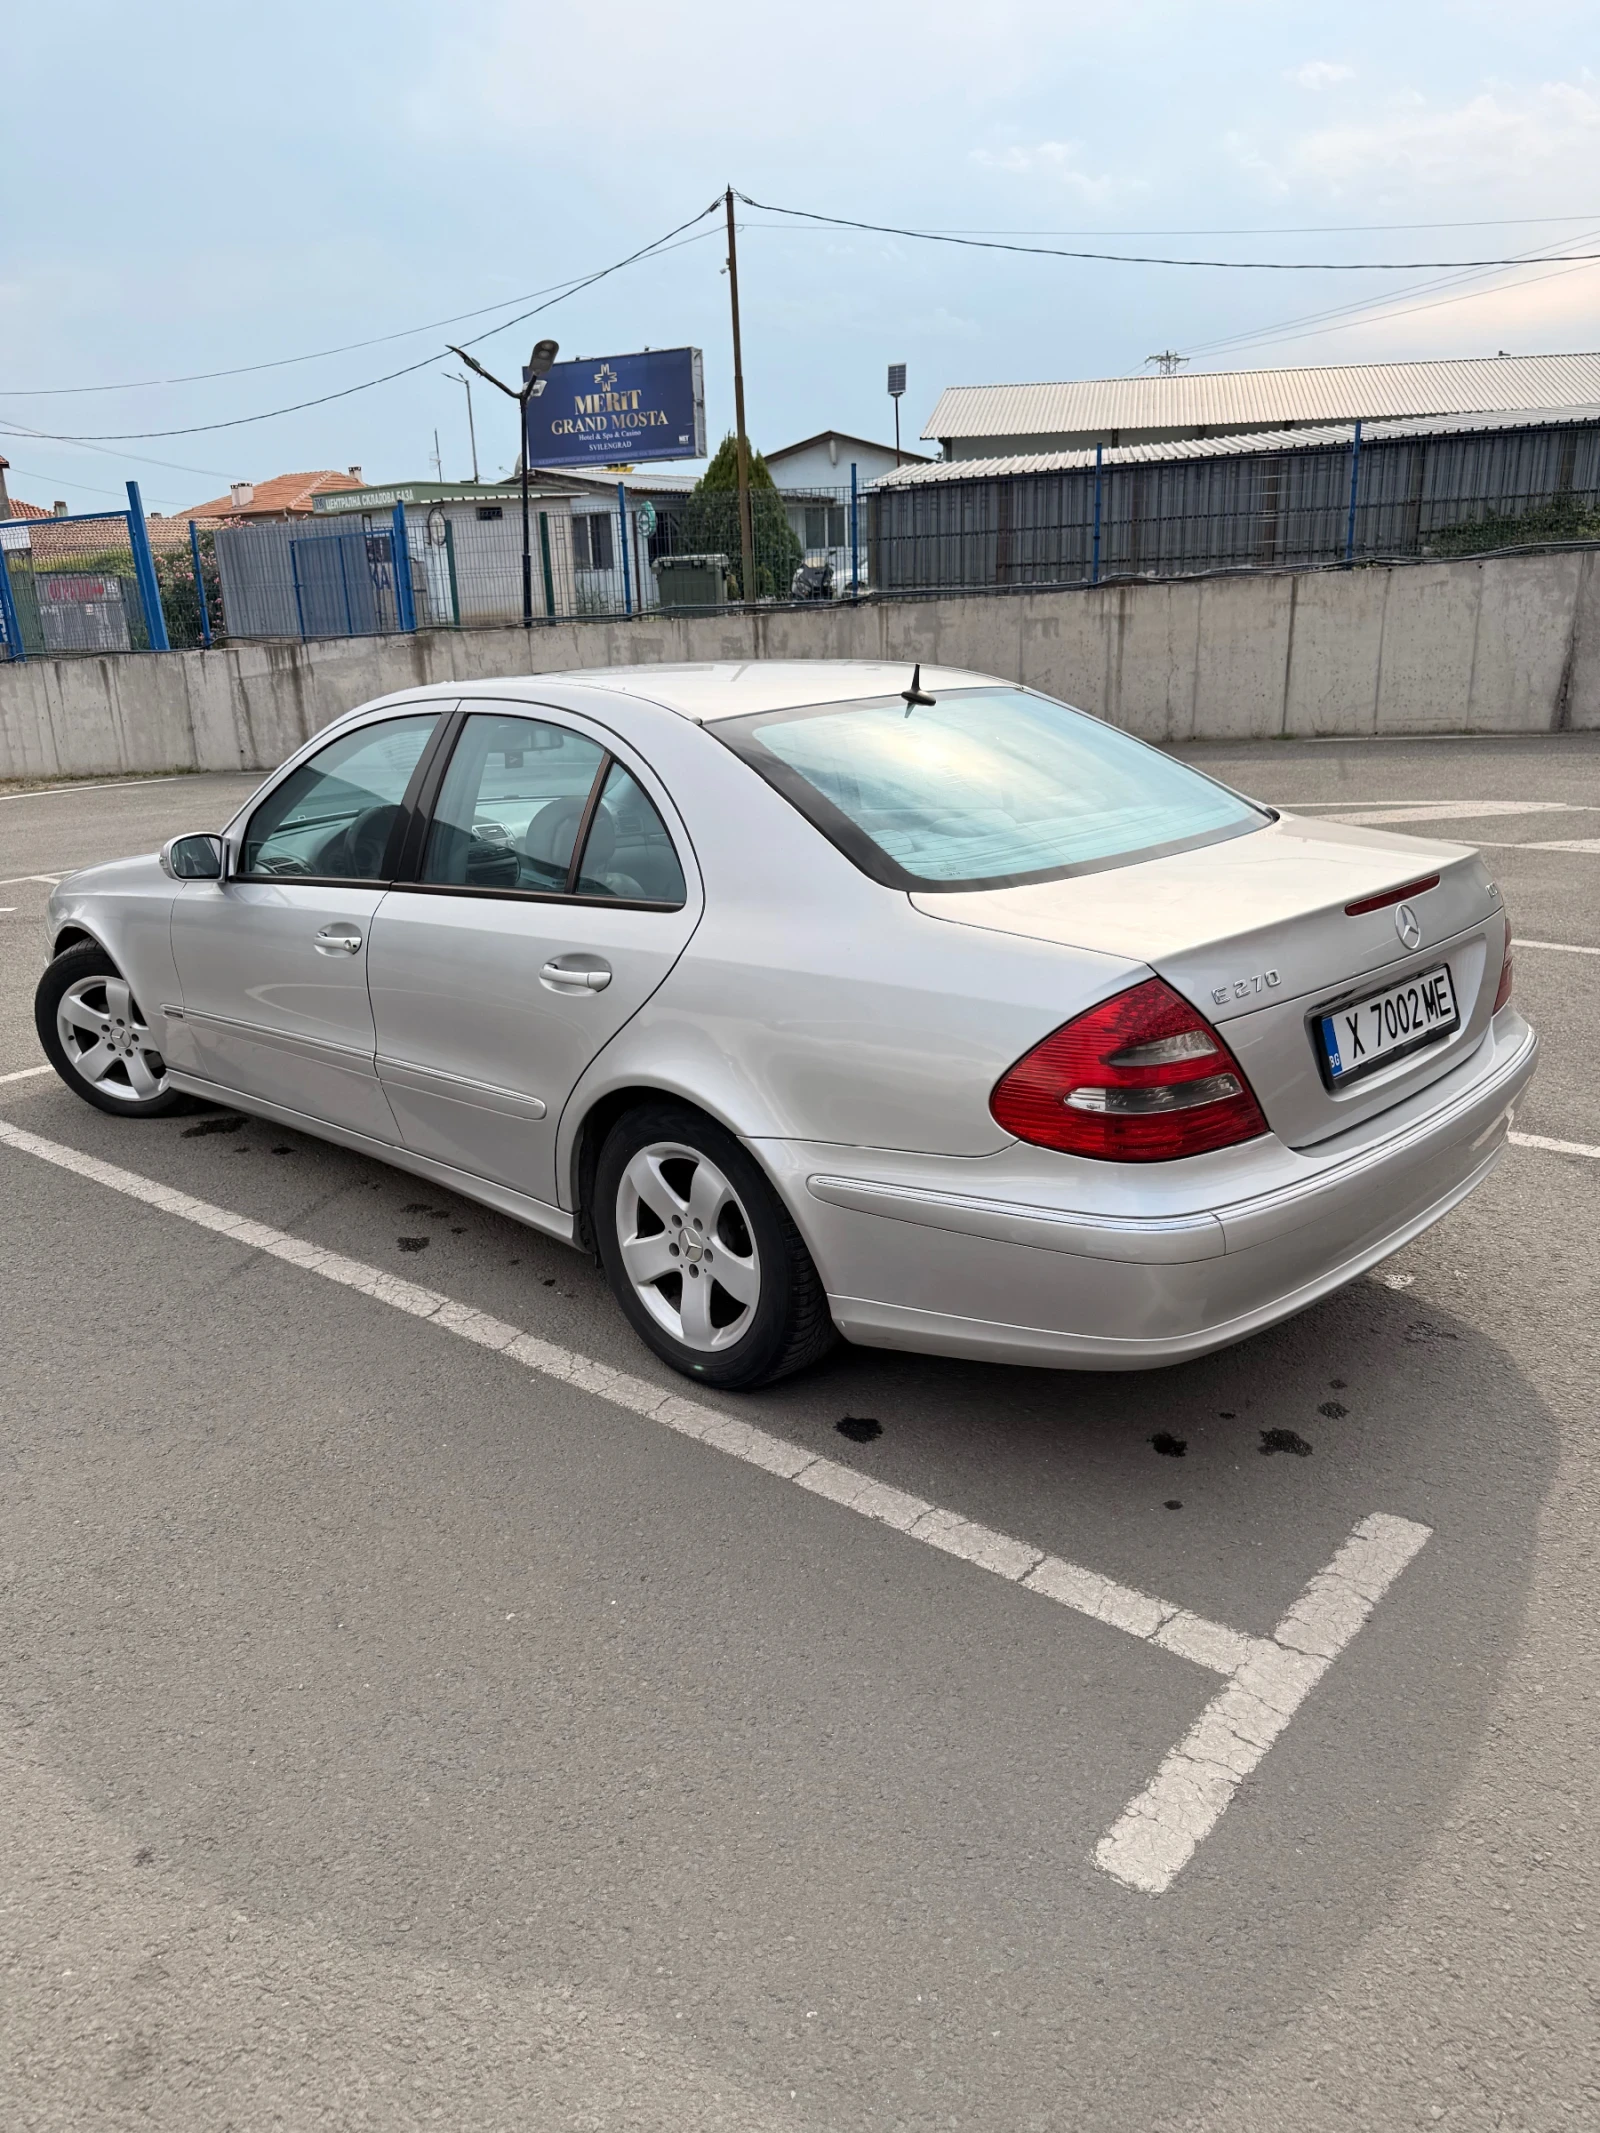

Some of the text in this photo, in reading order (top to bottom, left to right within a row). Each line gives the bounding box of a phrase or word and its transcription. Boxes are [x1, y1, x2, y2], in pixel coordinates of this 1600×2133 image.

[551, 410, 669, 436] GRAND MOSTA
[578, 432, 595, 441] Hotel
[602, 432, 614, 442] Spa
[621, 430, 642, 438] Casino
[588, 440, 632, 452] SVILENGRAD
[325, 495, 361, 511] ЦЕНТРАЛНА
[361, 491, 396, 506] СКЛАДОВА
[396, 488, 415, 502] БАЗА
[1210, 968, 1283, 1006] E 270
[1370, 987, 1424, 1049] 7002
[1423, 975, 1452, 1025] ME
[1328, 1054, 1342, 1070] BG
